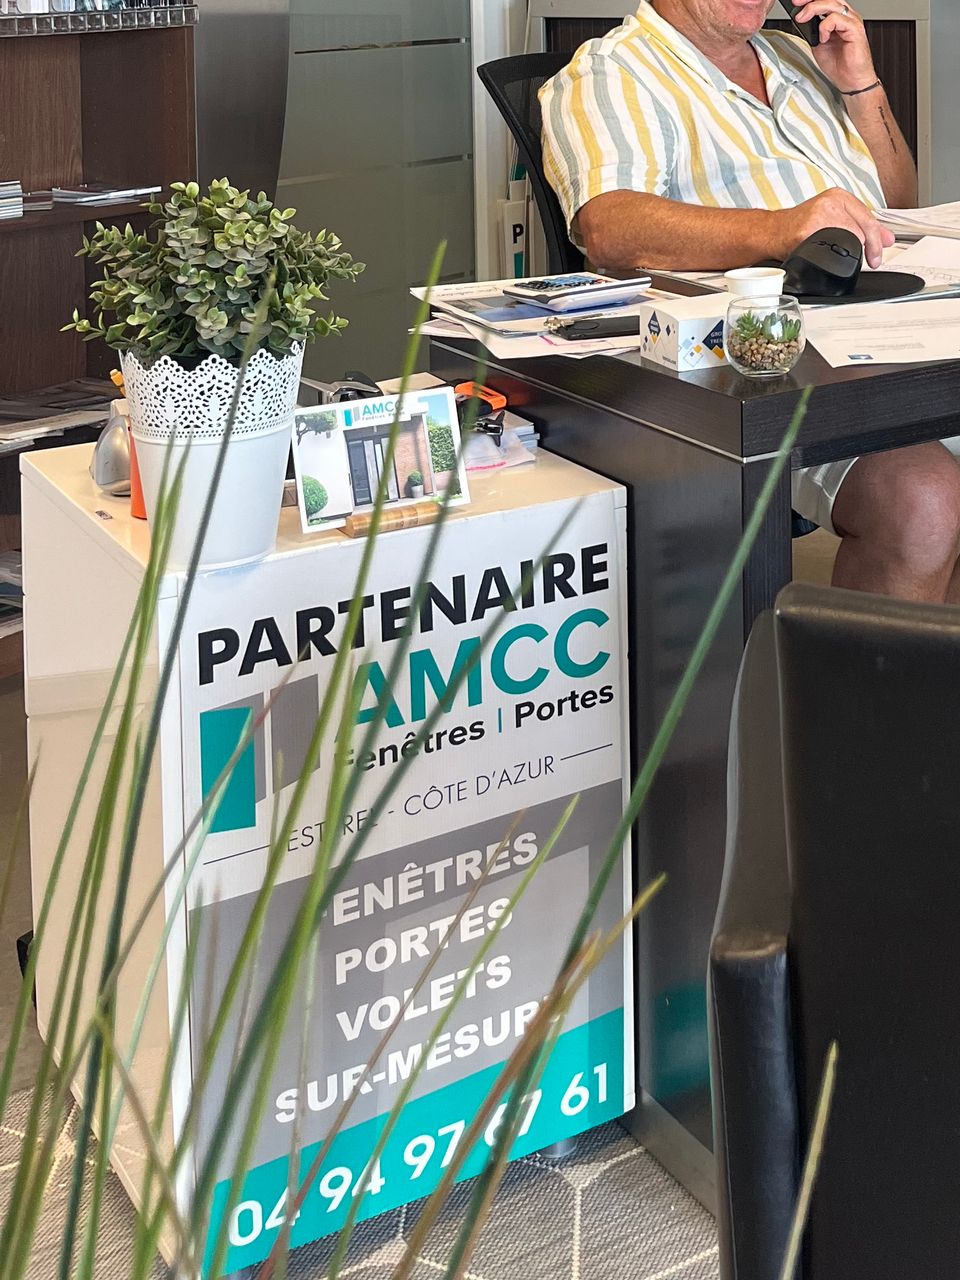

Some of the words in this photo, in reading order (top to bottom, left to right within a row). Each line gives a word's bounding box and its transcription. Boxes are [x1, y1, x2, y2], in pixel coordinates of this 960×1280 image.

[198, 543, 609, 686] PARTENAIRE
[334, 608, 611, 743] AMCC
[334, 721, 485, 772] enêtres
[515, 684, 614, 728] Portes
[287, 808, 378, 852] ESTRE
[404, 781, 467, 816] CÔTE
[476, 755, 554, 796] D'AZUR
[322, 832, 538, 926] ENÊTRES
[335, 897, 513, 985] PORTES
[336, 954, 512, 1042] VOLETS
[275, 995, 561, 1124] SUR-MESUR
[229, 1186, 300, 1247] 04
[319, 1157, 386, 1213] 94
[403, 1119, 465, 1180] 97
[560, 1062, 607, 1116] 61
